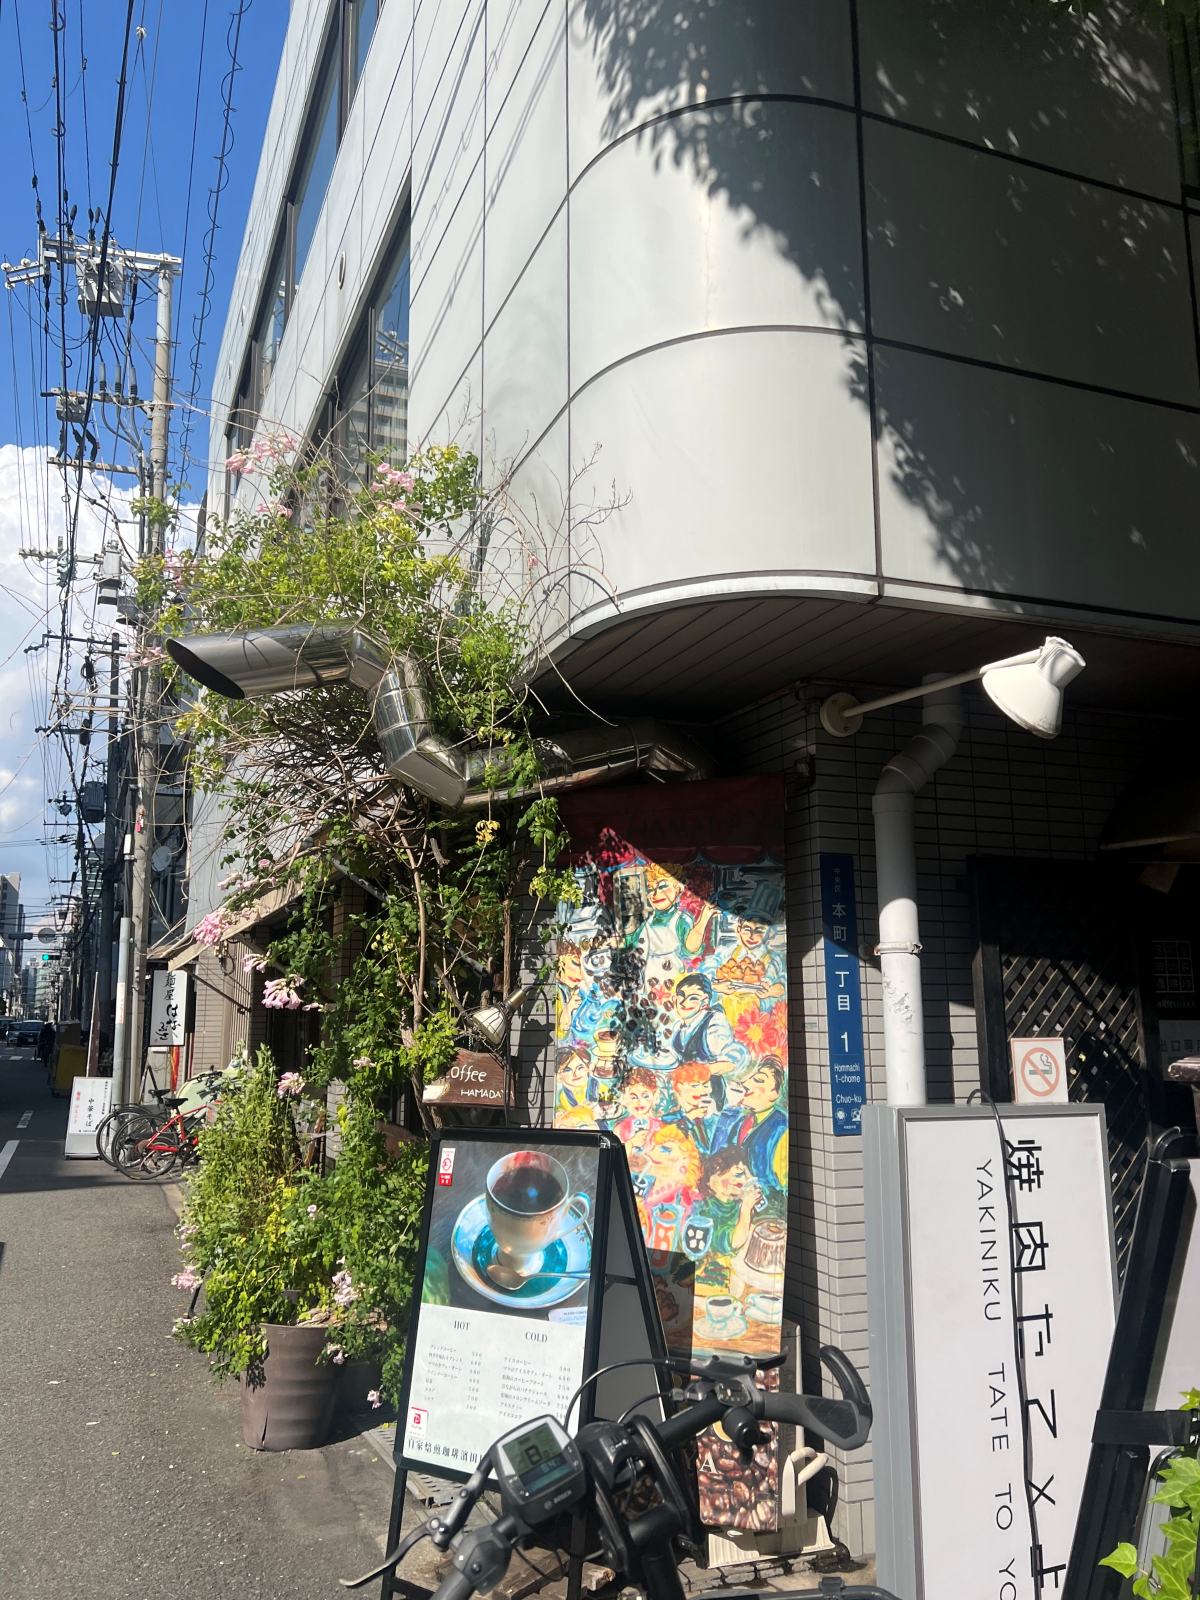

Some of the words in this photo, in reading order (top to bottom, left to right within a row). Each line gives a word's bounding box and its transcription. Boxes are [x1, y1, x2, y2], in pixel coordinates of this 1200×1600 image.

[831, 902, 851, 1012] 本町一丁目
[840, 1031, 850, 1053] 1
[834, 1063, 861, 1073] Hommachi
[835, 1075, 861, 1084] 1-chome
[835, 1094, 862, 1104] Chuo-ku
[975, 1157, 1003, 1323] YAKINIKU
[453, 1320, 471, 1332] HOT
[524, 1331, 548, 1344] COLD
[987, 1362, 1010, 1453] TATE
[994, 1482, 1013, 1531] TO
